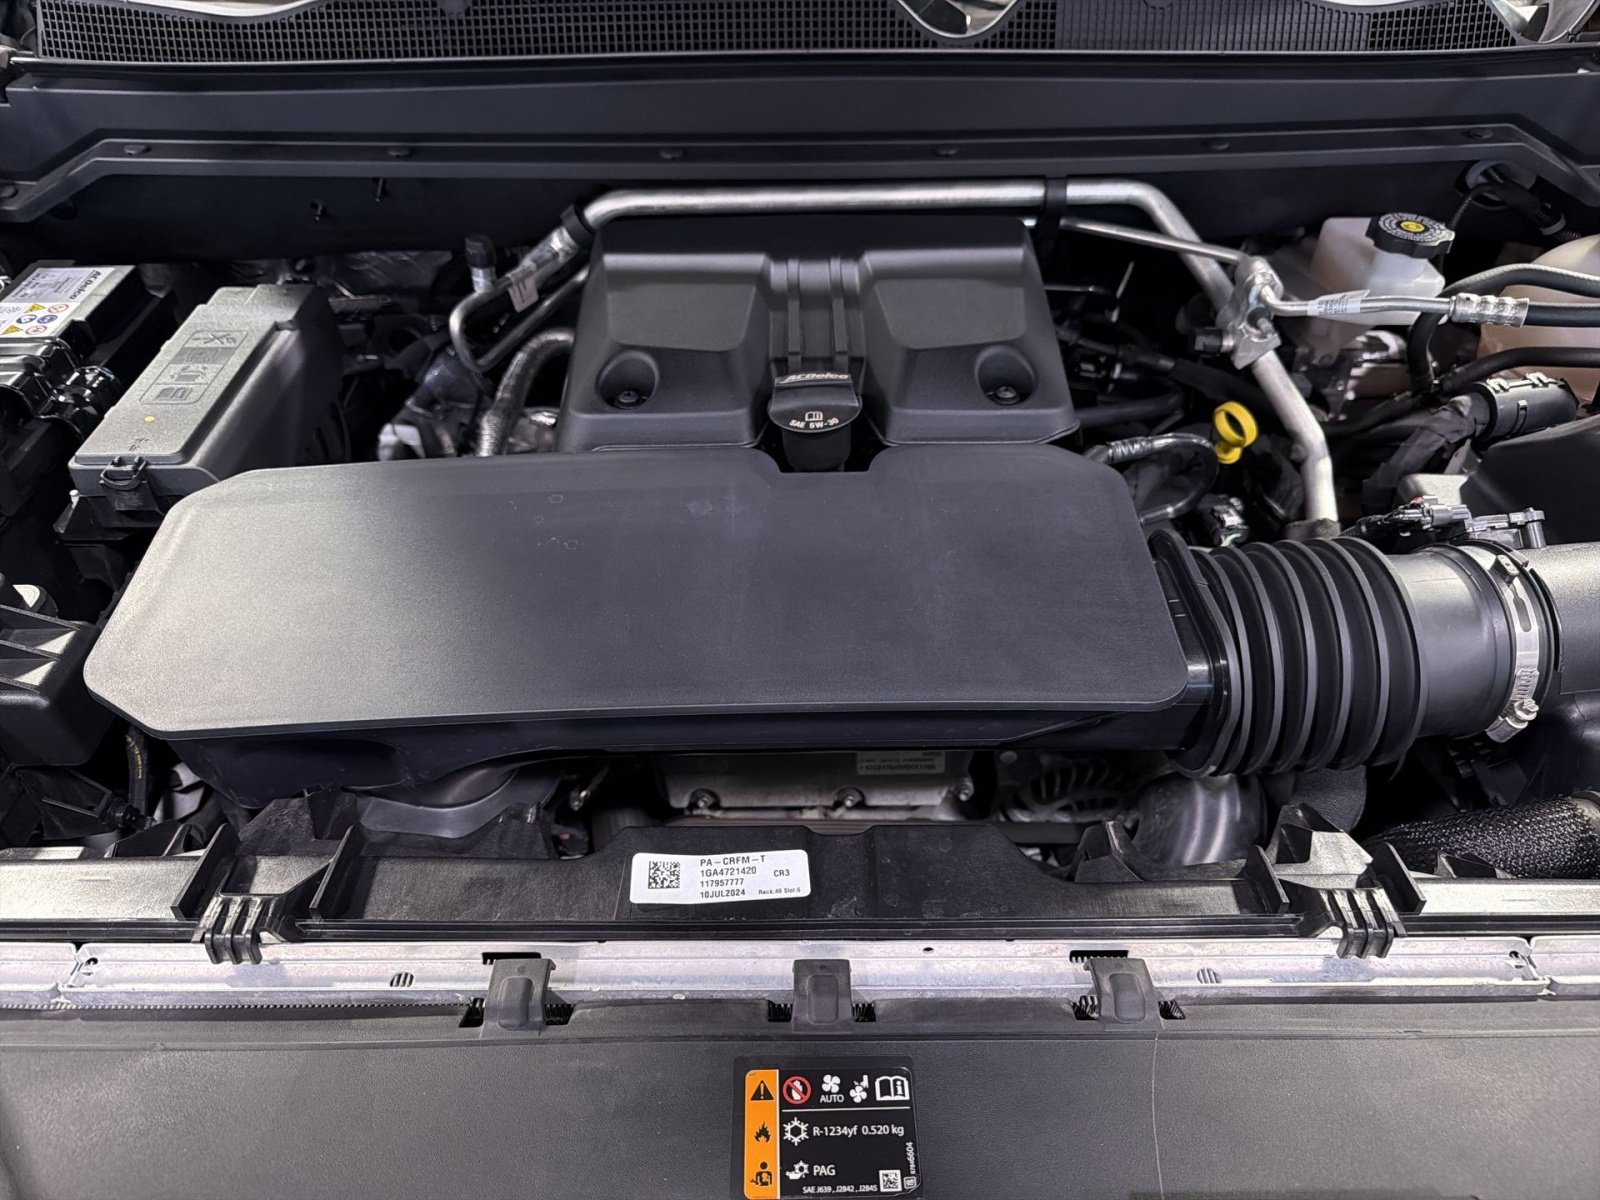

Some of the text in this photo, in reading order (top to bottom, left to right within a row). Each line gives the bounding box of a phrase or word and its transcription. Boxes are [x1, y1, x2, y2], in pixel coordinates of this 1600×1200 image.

[789, 417, 839, 429] SAE 5W-30
[700, 866, 757, 877] 1GA4721420
[773, 869, 790, 877] CR3
[700, 878, 744, 887] 117957777
[700, 889, 745, 898] 10JUL2024
[820, 1094, 844, 1103] AUTO
[812, 1124, 904, 1137] R-1234yf 0.520 kg
[813, 1165, 836, 1176] PAG
[802, 1186, 816, 1194] SAE
